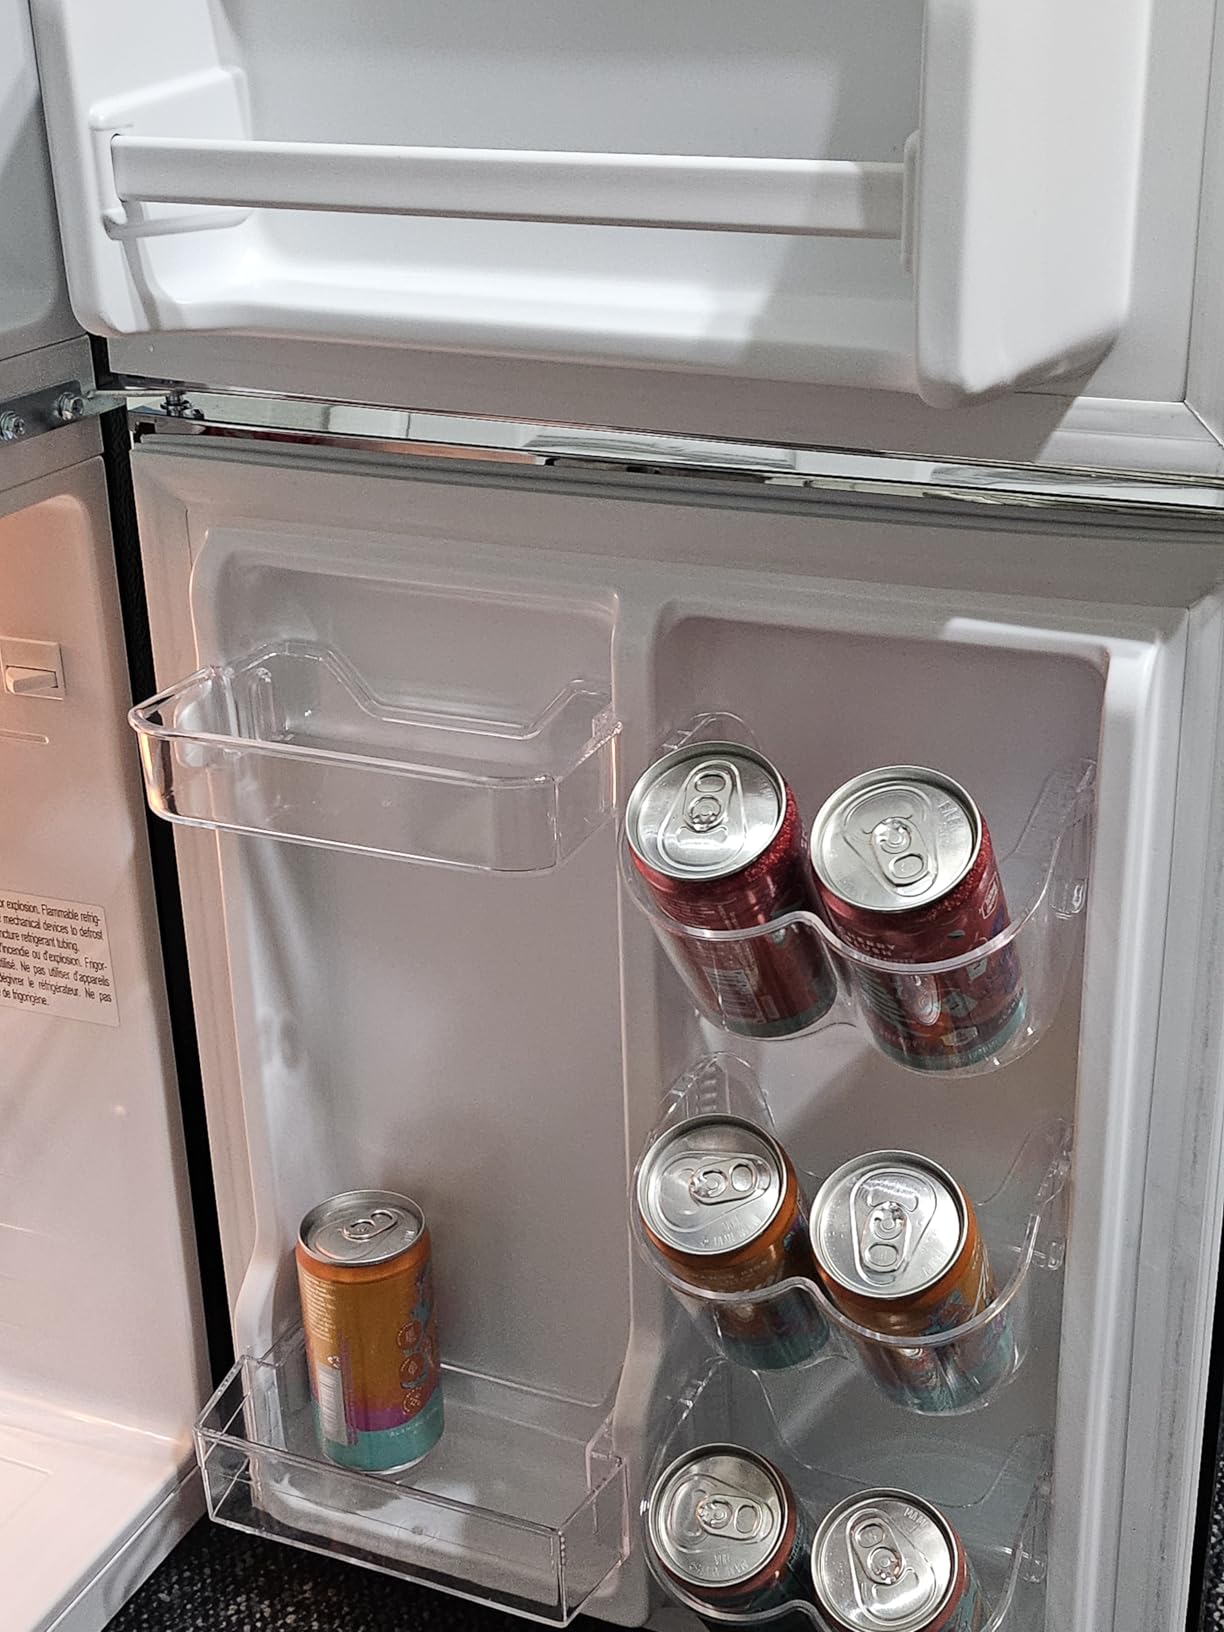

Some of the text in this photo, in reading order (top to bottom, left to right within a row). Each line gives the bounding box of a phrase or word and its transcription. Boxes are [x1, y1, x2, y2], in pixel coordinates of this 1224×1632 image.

[7, 900, 40, 914] explosion.
[41, 904, 79, 921] Flammable
[81, 912, 101, 926] refrig-
[3, 915, 41, 929] mechanical
[43, 920, 69, 934] devices
[70, 925, 78, 936] to
[80, 927, 104, 940] defrost
[21, 932, 55, 947] refrigerant
[57, 938, 79, 954] tubing.
[32, 950, 40, 960] ou
[20, 960, 30, 972] Ne
[33, 966, 46, 976] pas
[73, 971, 110, 987] d'appareils
[2, 988, 11, 998] de
[28, 976, 34, 988] le
[85, 987, 95, 1000] Ne
[99, 992, 112, 1003] pas
